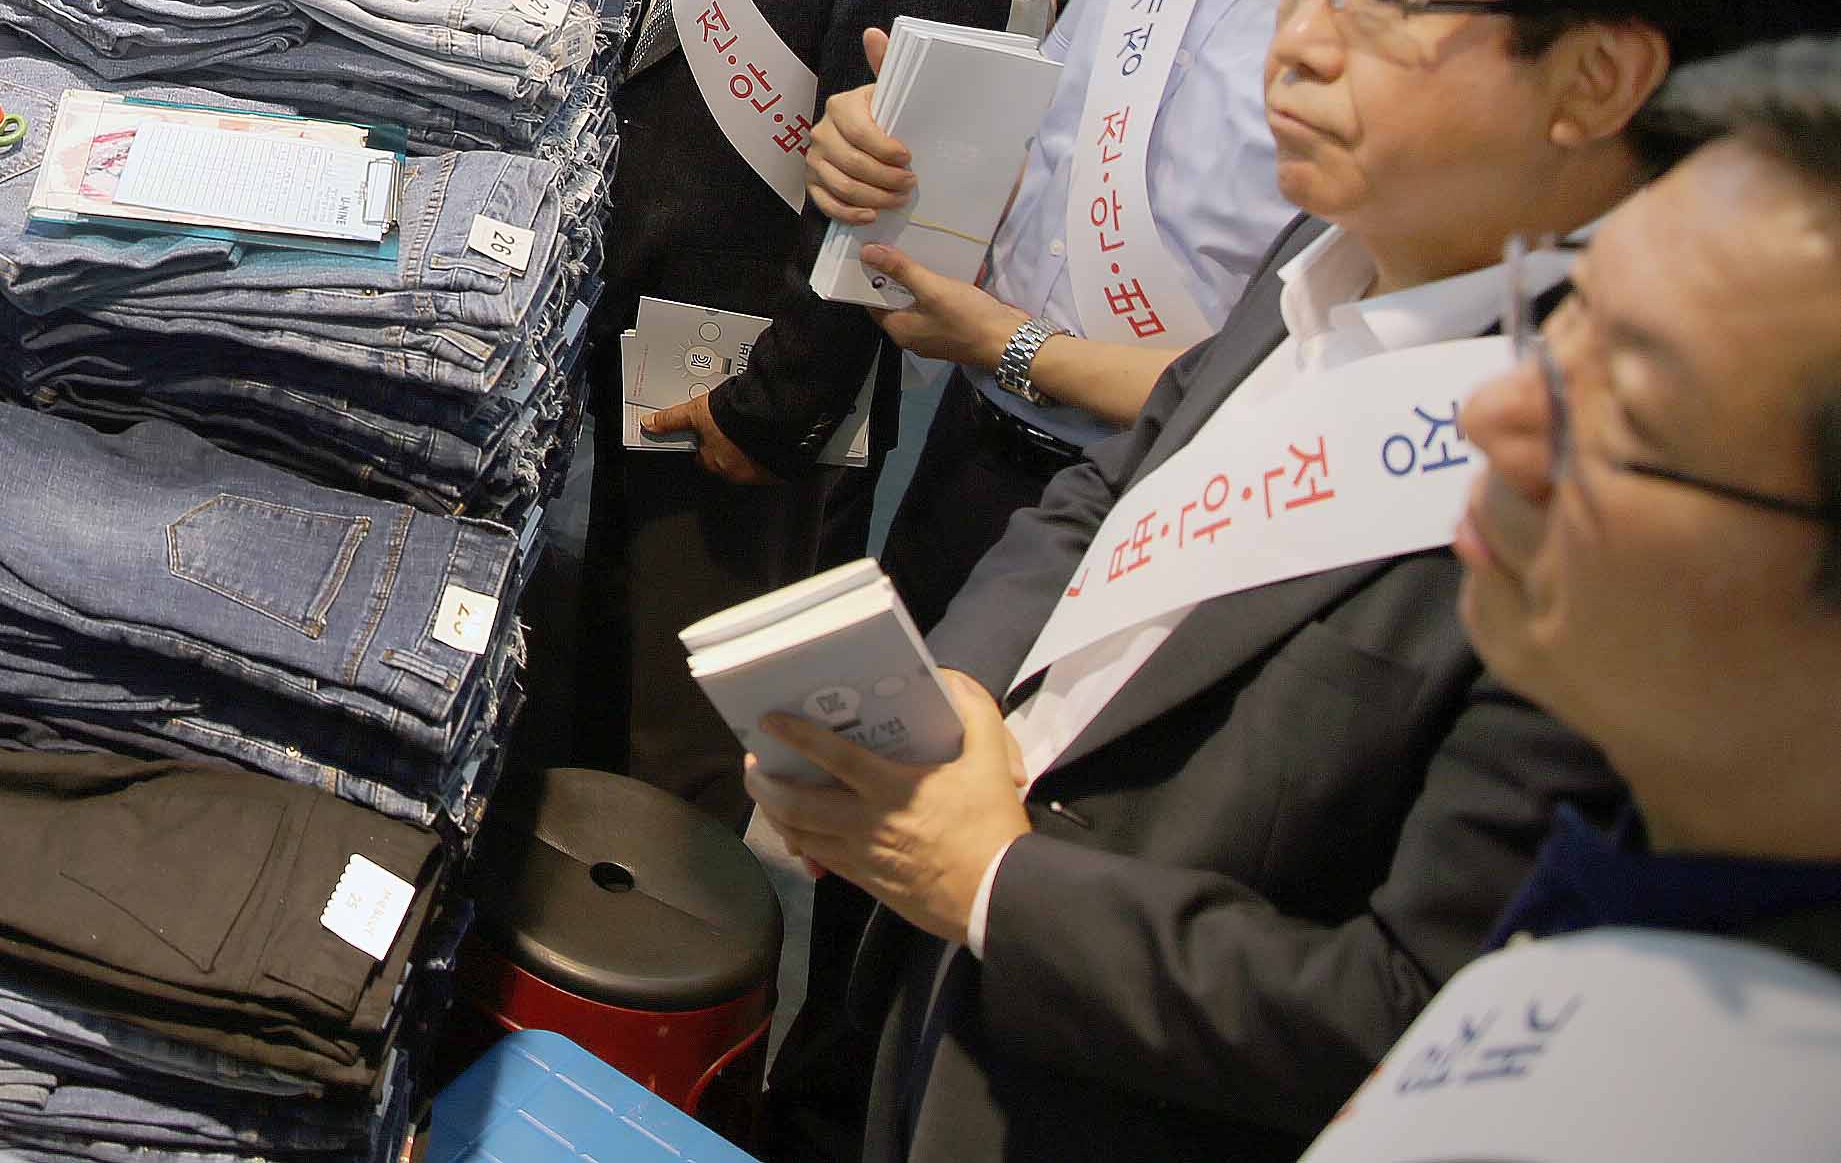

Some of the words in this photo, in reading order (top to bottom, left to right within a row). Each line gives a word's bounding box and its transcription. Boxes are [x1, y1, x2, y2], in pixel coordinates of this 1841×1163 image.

[335, 196, 351, 226] U-NINE
[492, 225, 518, 260] 26
[1090, 105, 1167, 339] 전·안·법
[1106, 436, 1337, 583] 전·안·법
